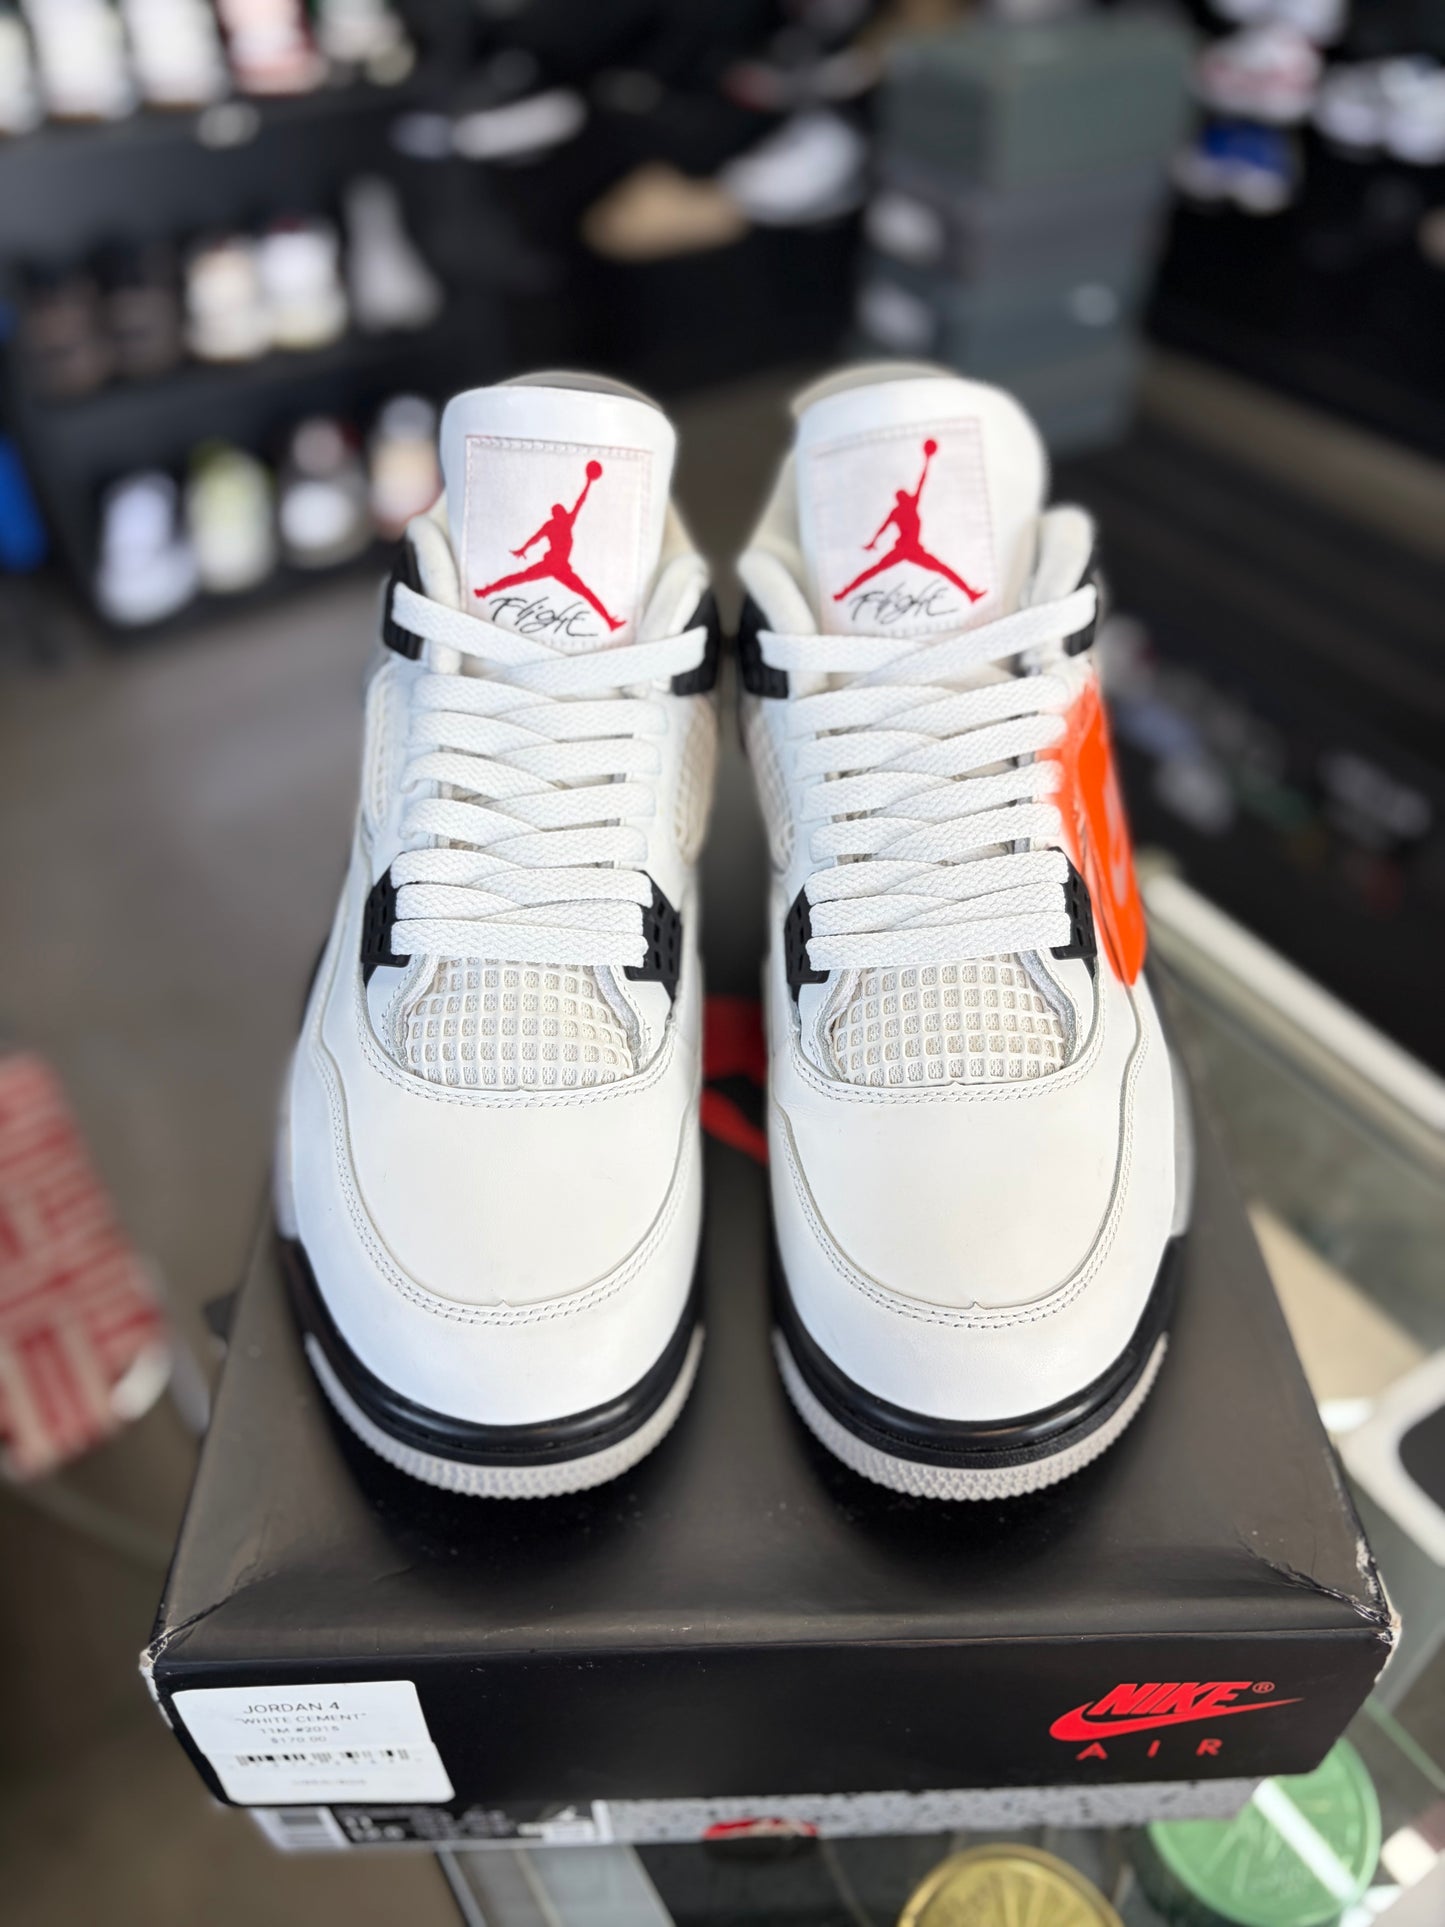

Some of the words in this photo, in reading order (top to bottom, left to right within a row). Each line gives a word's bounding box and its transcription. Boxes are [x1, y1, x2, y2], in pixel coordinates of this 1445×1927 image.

[489, 596, 599, 637] Flight
[847, 579, 959, 625] Flight
[243, 1703, 323, 1714] JORDAN
[330, 1702, 340, 1710] 4
